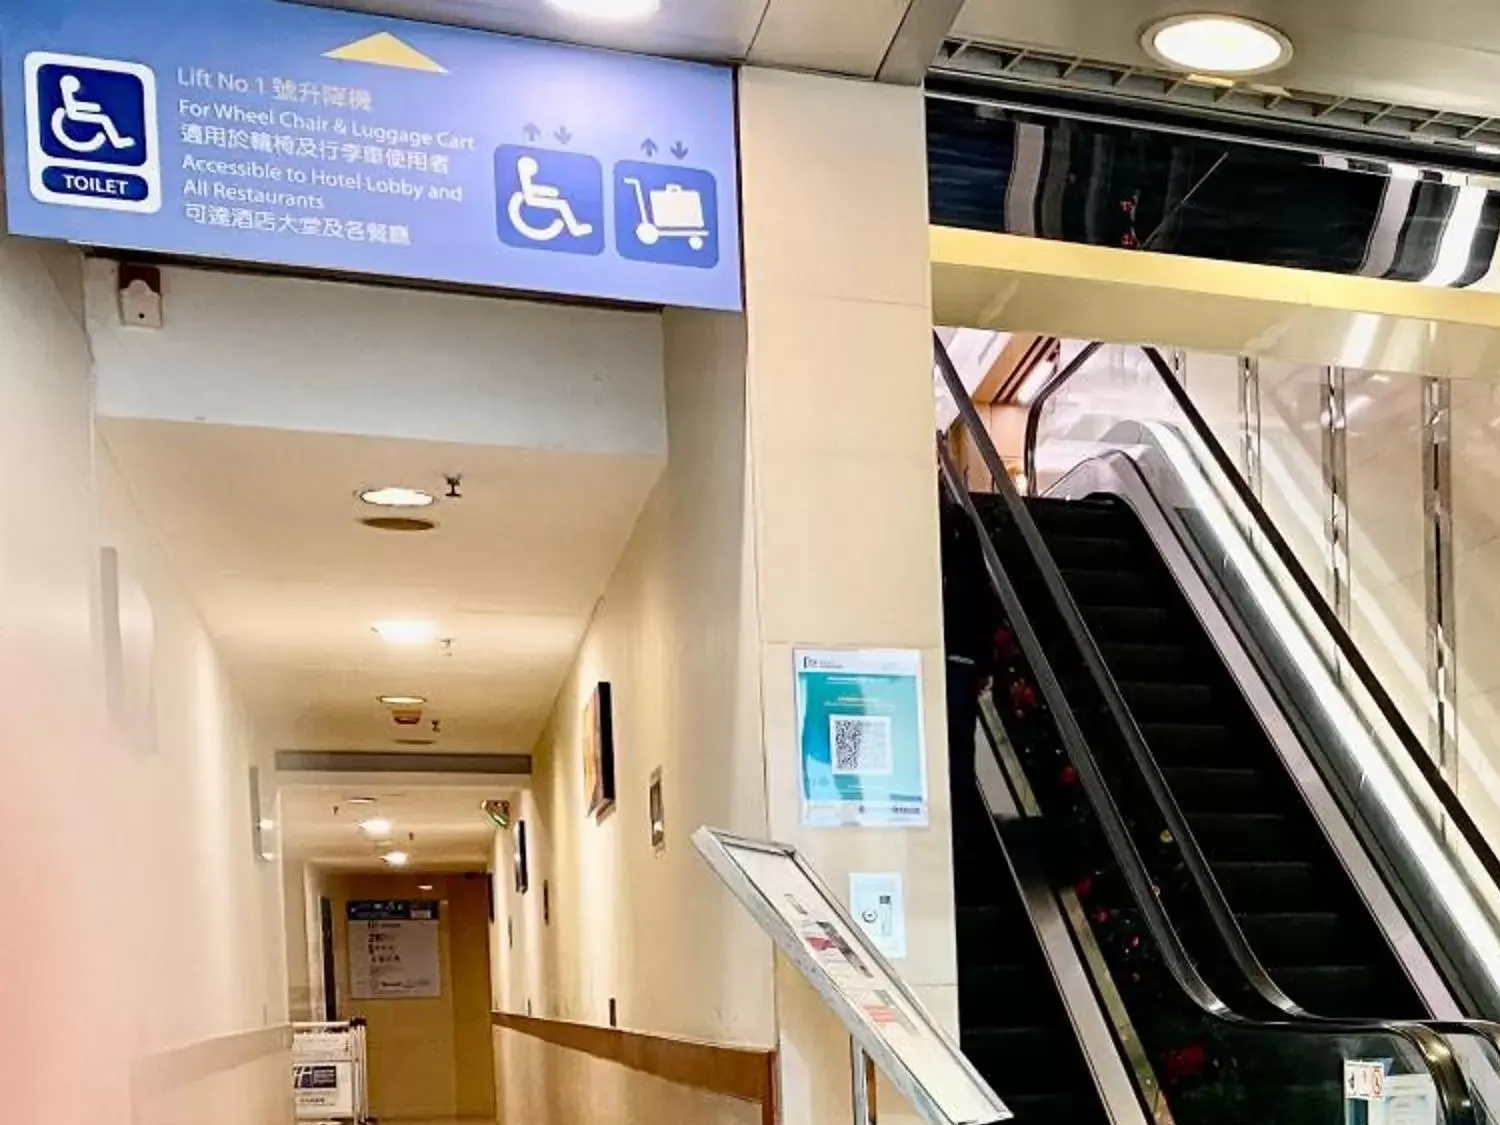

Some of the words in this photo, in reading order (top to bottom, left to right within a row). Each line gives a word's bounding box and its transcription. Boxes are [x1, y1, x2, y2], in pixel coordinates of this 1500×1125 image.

[177, 66, 211, 88] Lift
[218, 72, 249, 93] No
[255, 77, 264, 95] 1
[179, 99, 212, 118] For
[214, 102, 275, 125] Wheel
[279, 109, 329, 133] Chair
[333, 118, 347, 134] &
[352, 120, 433, 147] Luggage
[437, 131, 476, 150] Cart
[61, 173, 129, 195] TOILET
[182, 153, 282, 181] Accessible
[286, 166, 307, 184] to
[311, 167, 361, 190] Hotel
[366, 176, 424, 201] Lobby
[428, 185, 463, 202] and
[183, 178, 208, 198] All
[213, 181, 324, 209] Restaurants
